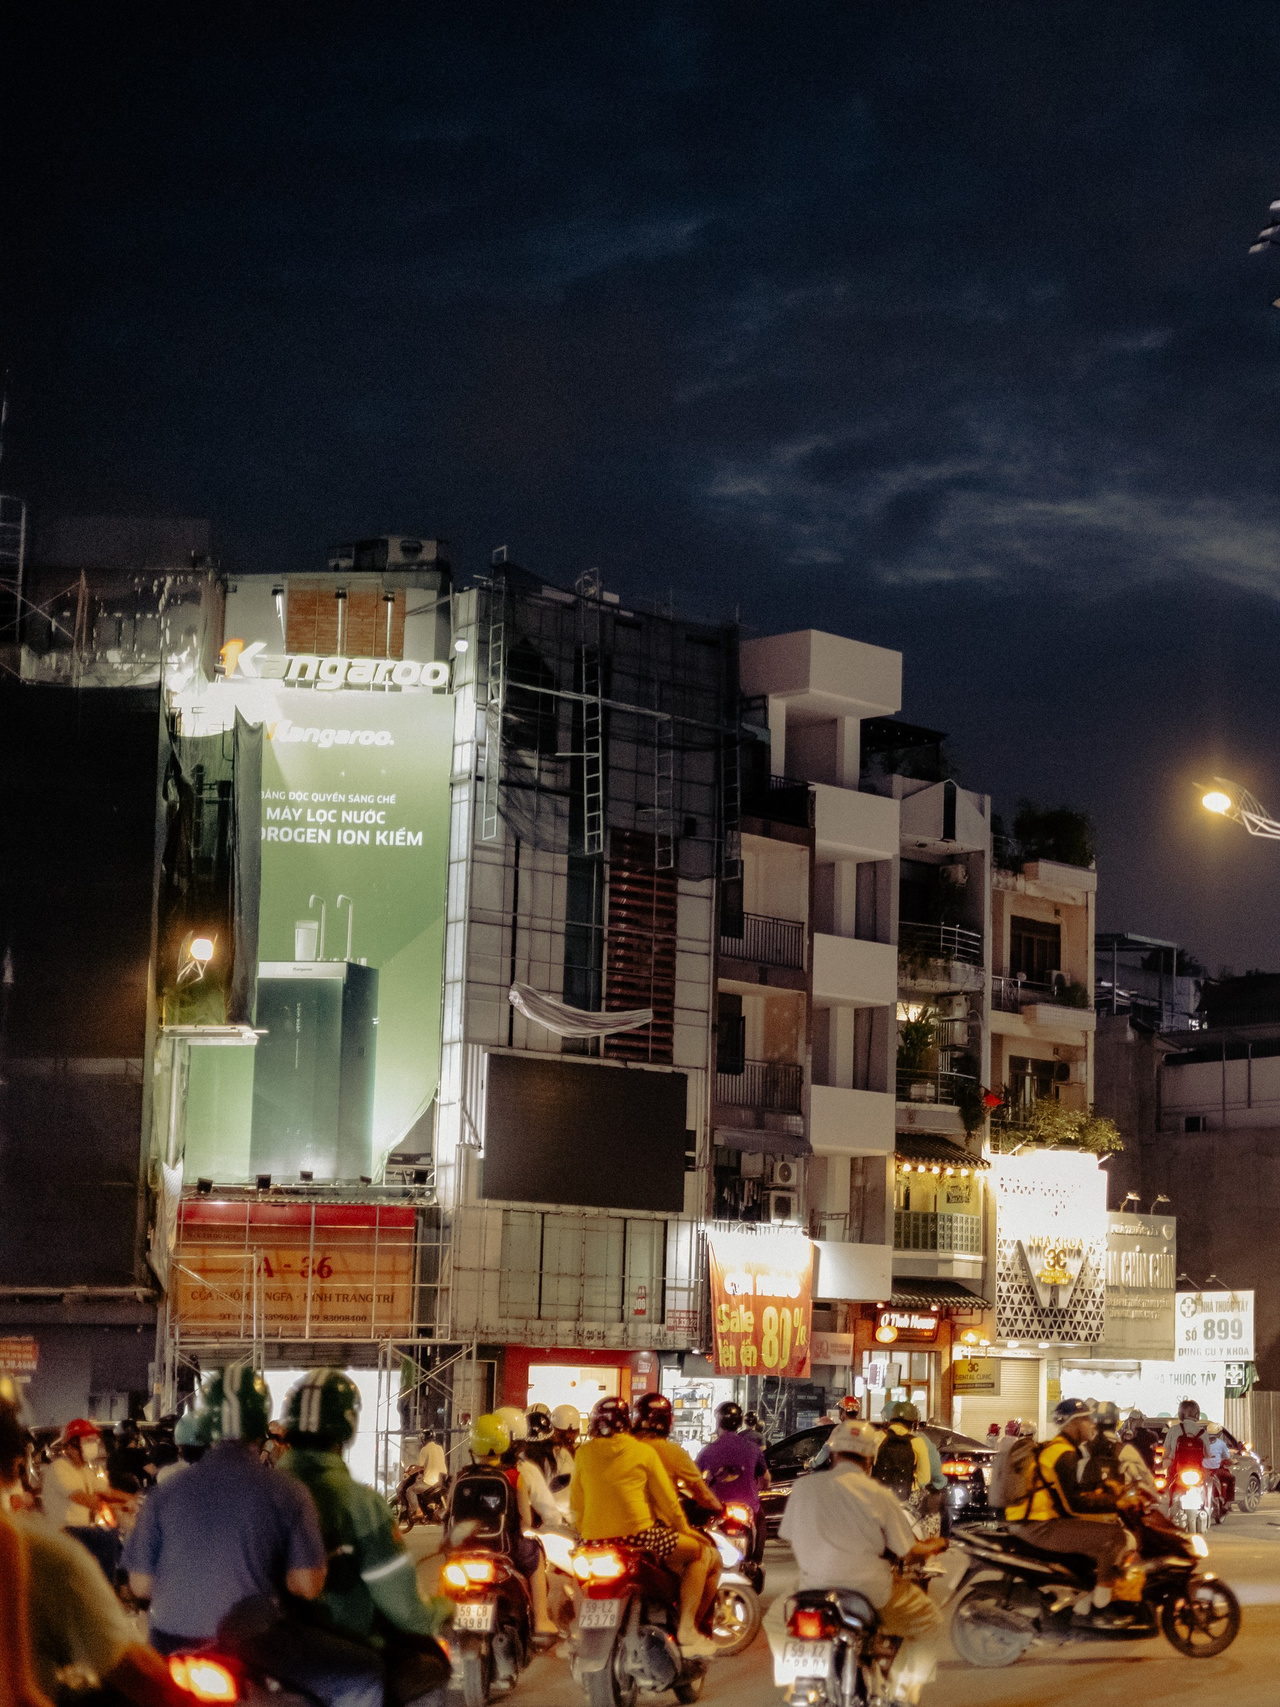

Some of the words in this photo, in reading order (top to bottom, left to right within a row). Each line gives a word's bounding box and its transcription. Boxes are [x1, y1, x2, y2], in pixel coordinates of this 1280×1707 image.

[288, 790, 309, 803] ĐỘC
[348, 792, 375, 804] SÁNG
[377, 793, 397, 805] CHẾ
[266, 805, 303, 821] MÁY
[306, 808, 338, 825] LỌC
[341, 808, 387, 825] NƯỚC
[300, 1255, 334, 1279] 36
[335, 1292, 374, 1304] TRANG
[716, 1303, 755, 1334] Sale
[1185, 1325, 1198, 1342] SỐ
[1203, 1318, 1244, 1341] 899
[1226, 1346, 1251, 1357] KHOA
[967, 1362, 980, 1373] 3C
